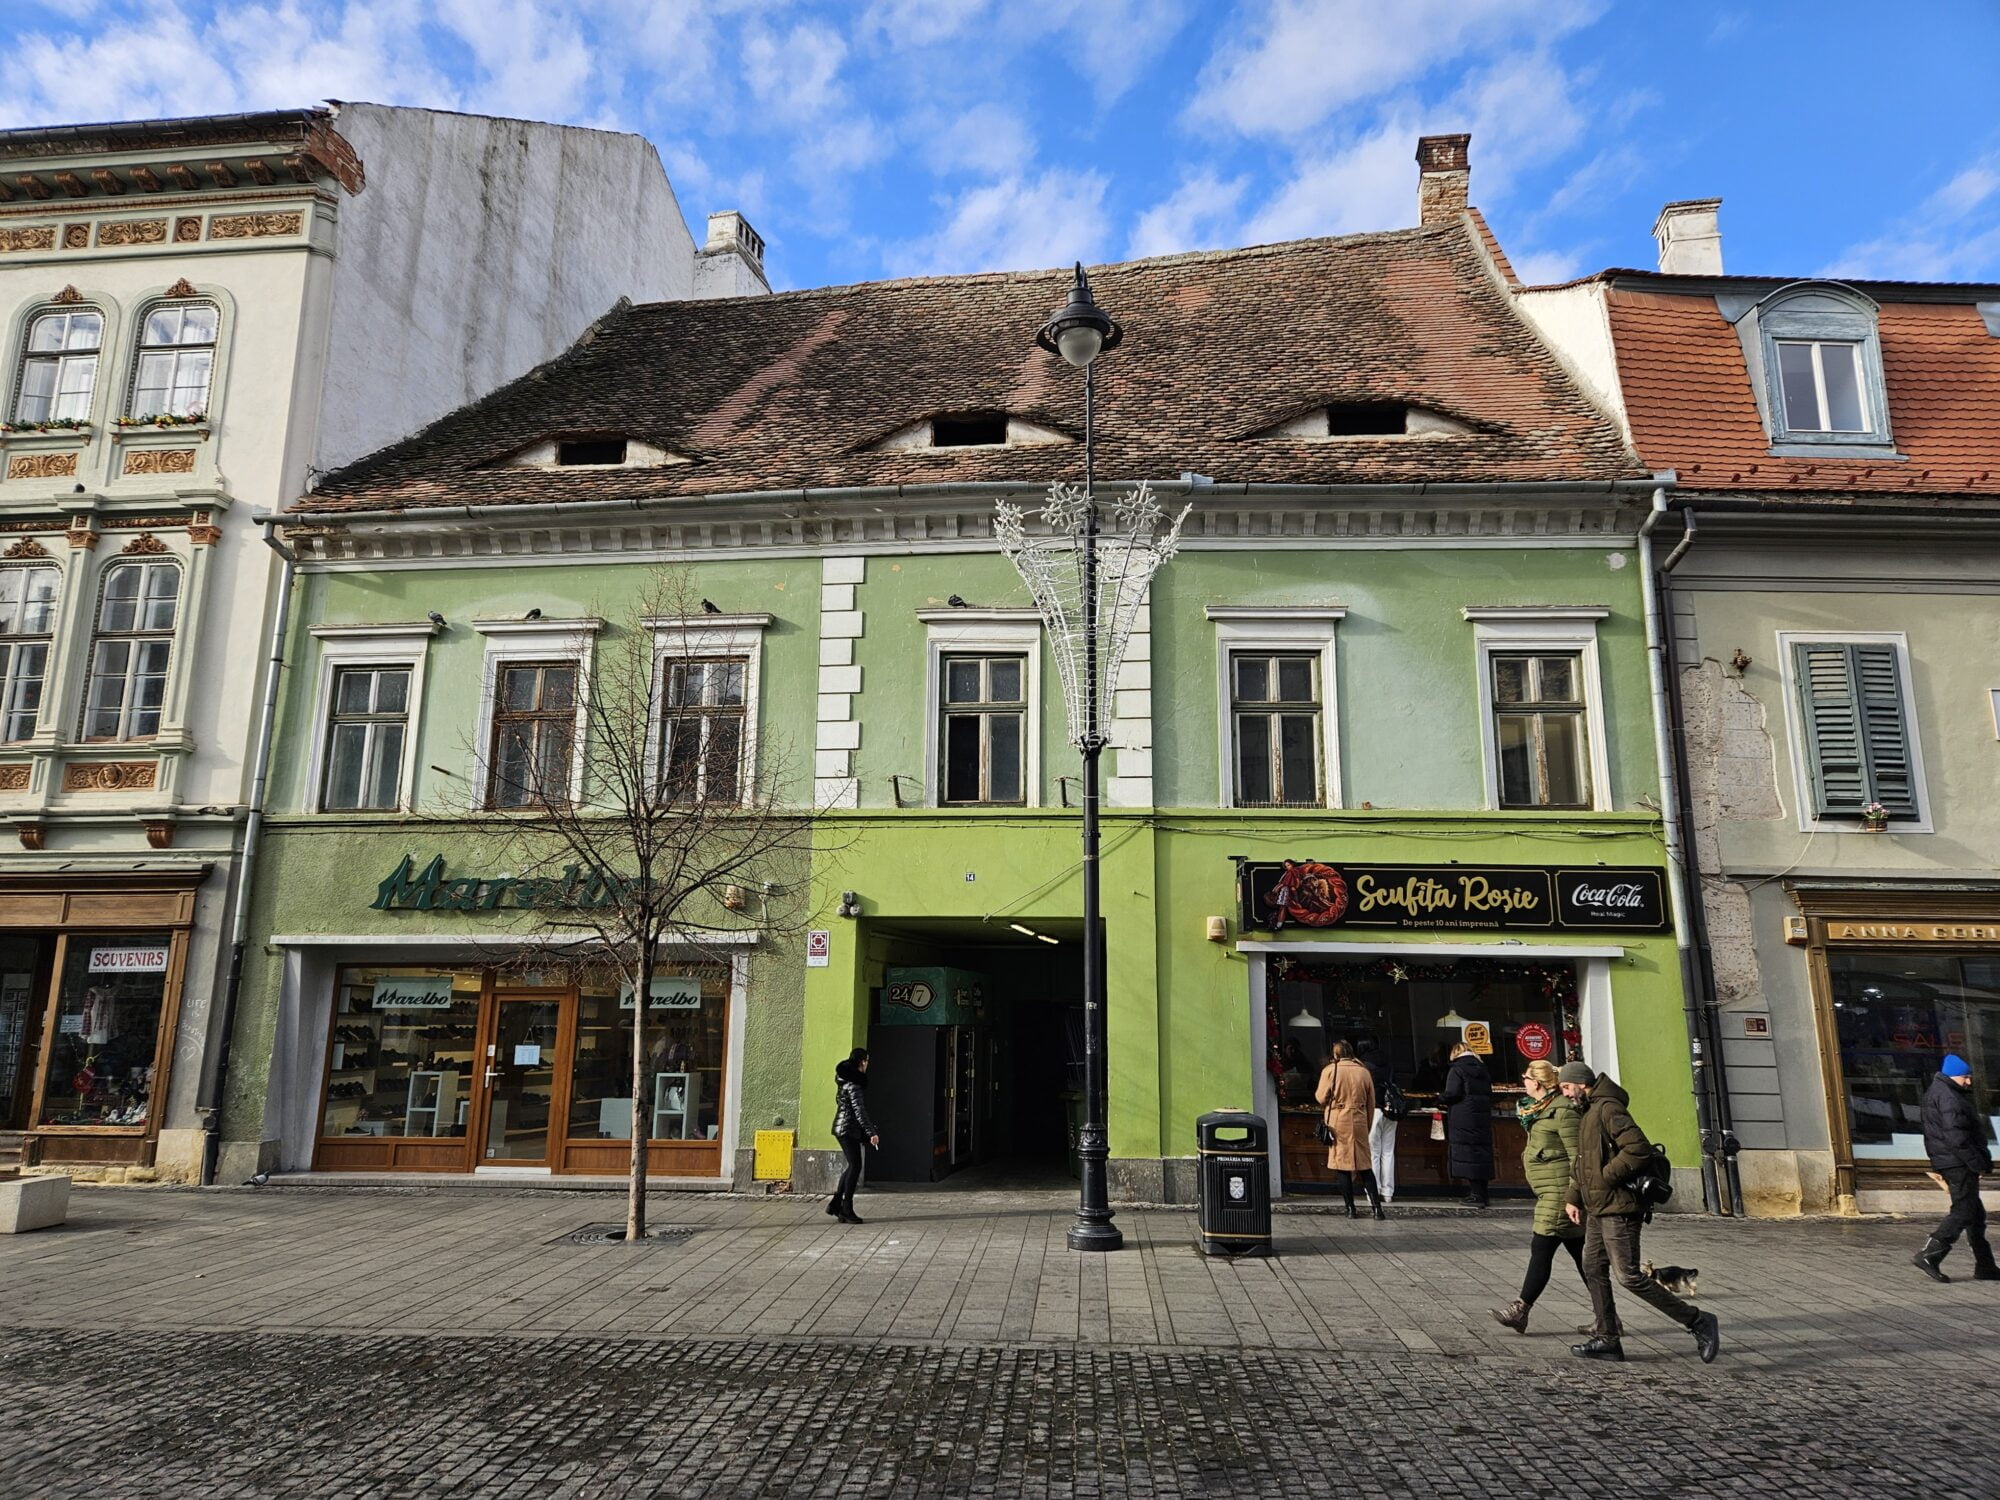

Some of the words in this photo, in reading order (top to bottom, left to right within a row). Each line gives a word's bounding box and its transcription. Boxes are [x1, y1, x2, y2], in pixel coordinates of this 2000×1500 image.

[1571, 883, 1644, 907] Coca-Cola
[1414, 919, 1435, 927] peste
[1842, 926, 1919, 938] ANNA
[93, 951, 164, 967] SOUVENIRS
[376, 988, 448, 1005] Marelbo
